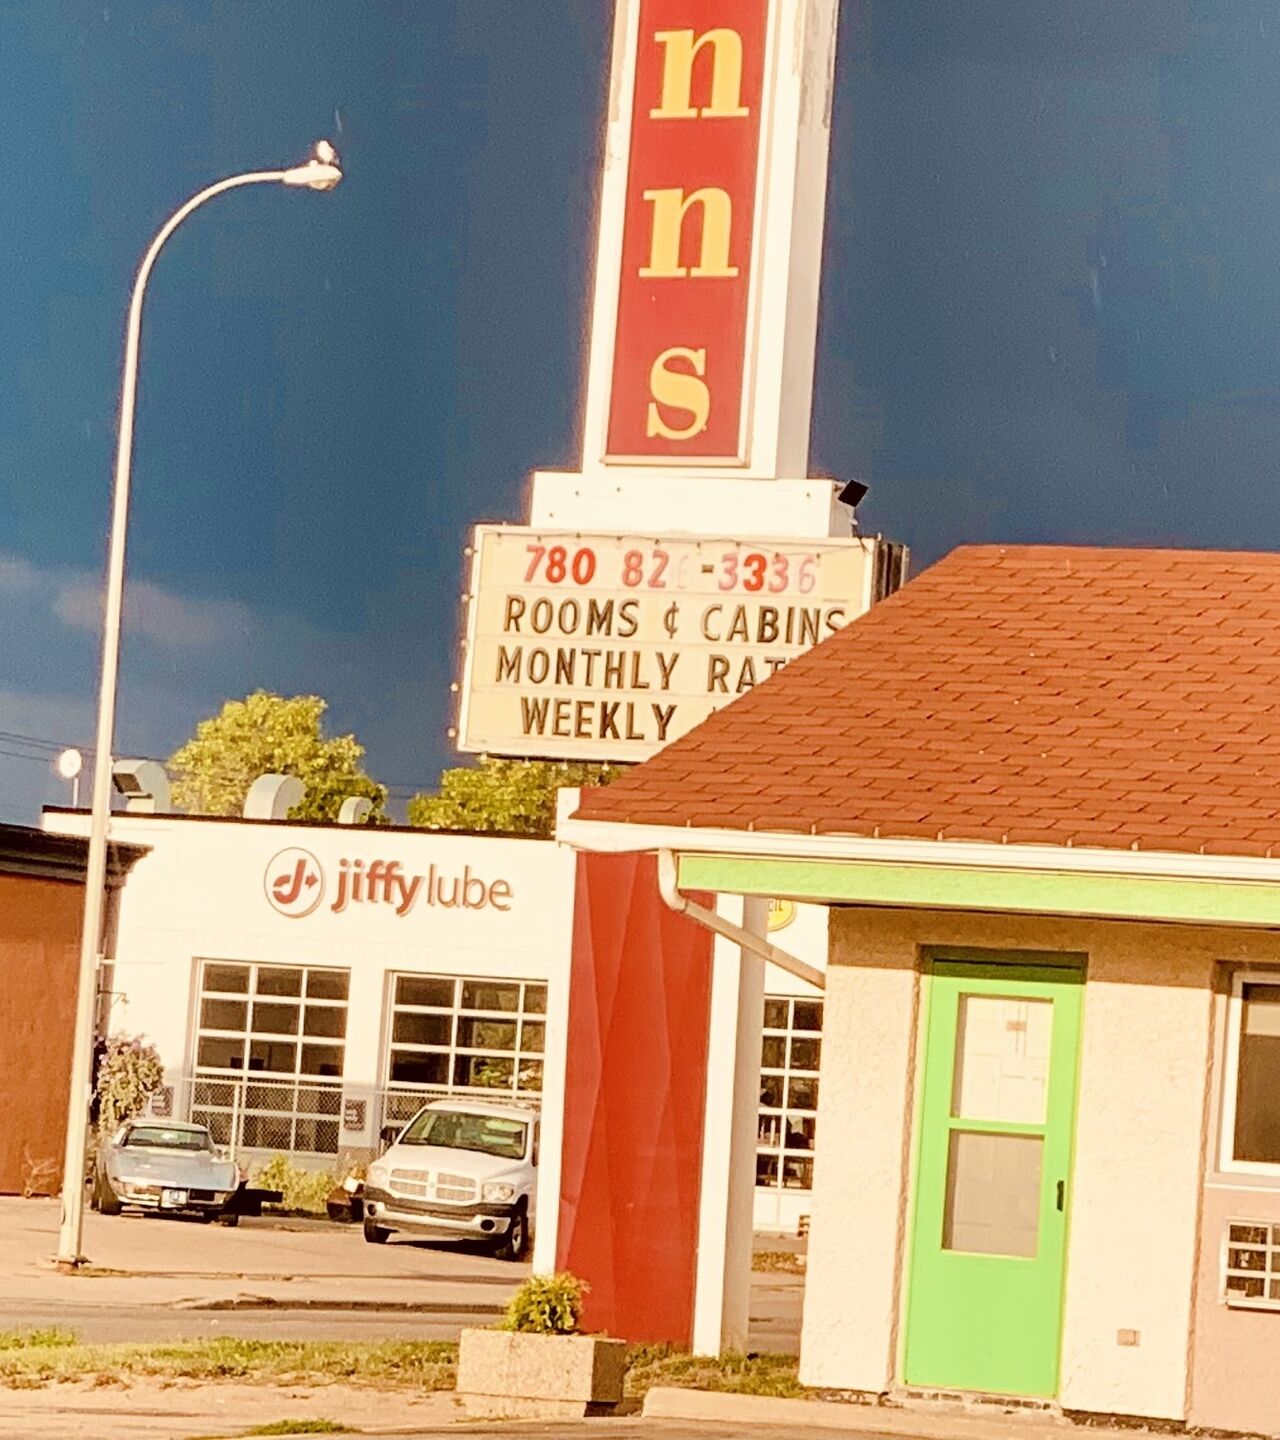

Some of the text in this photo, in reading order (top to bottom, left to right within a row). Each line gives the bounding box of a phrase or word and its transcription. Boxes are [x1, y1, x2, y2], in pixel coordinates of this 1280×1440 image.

[524, 545, 597, 586] 780
[503, 594, 640, 638] ROOMS
[495, 645, 680, 691] MONTHLY
[520, 696, 678, 742] WEEKLY
